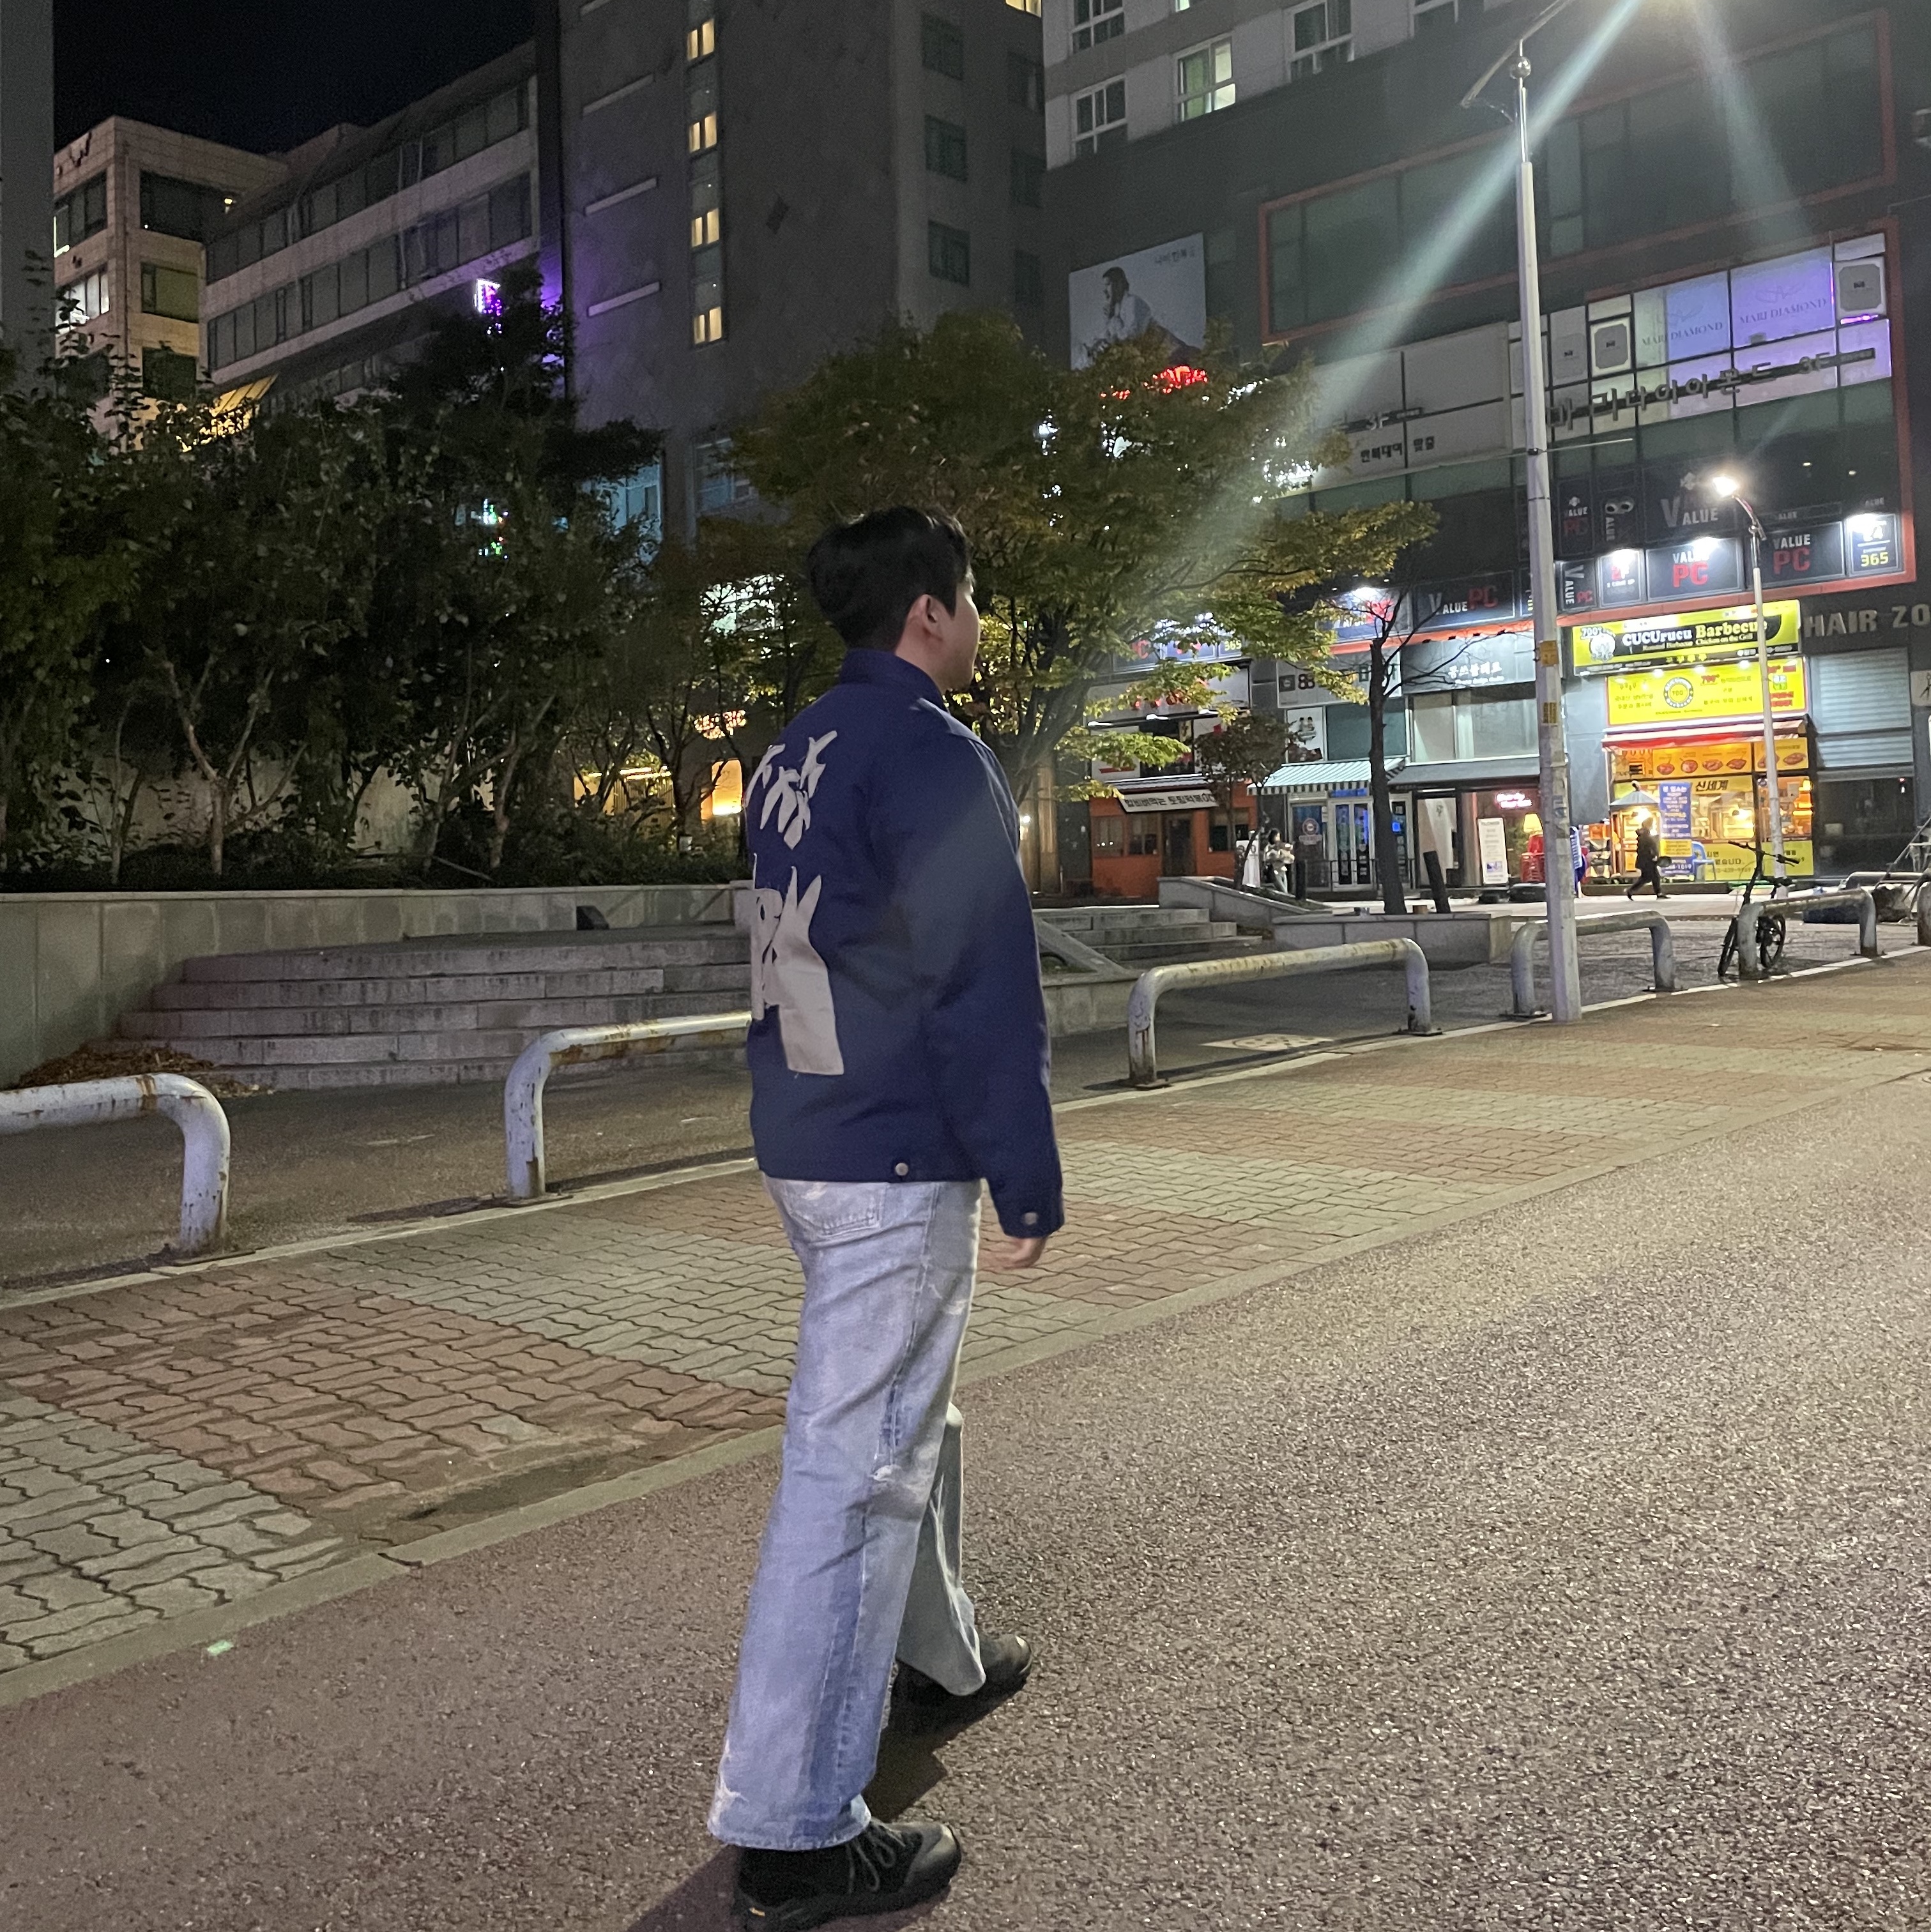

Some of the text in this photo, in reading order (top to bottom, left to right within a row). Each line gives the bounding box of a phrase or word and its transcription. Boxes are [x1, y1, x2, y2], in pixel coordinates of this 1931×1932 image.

[1740, 298, 1827, 324] MARI DIAMOND
[1670, 321, 1723, 341] DIAMOND
[1798, 351, 1830, 375] 3F
[1773, 534, 1811, 550] VALUE
[1672, 549, 1710, 563] VAL
[1773, 547, 1811, 575] PC
[1861, 551, 1889, 567] 365
[1673, 561, 1709, 588] PC
[1428, 593, 1469, 615] VALUE
[1469, 586, 1499, 611] PC
[1803, 604, 1930, 637] HAIR ZO
[1225, 639, 1242, 651] 365
[1696, 779, 1729, 792] 신세계
